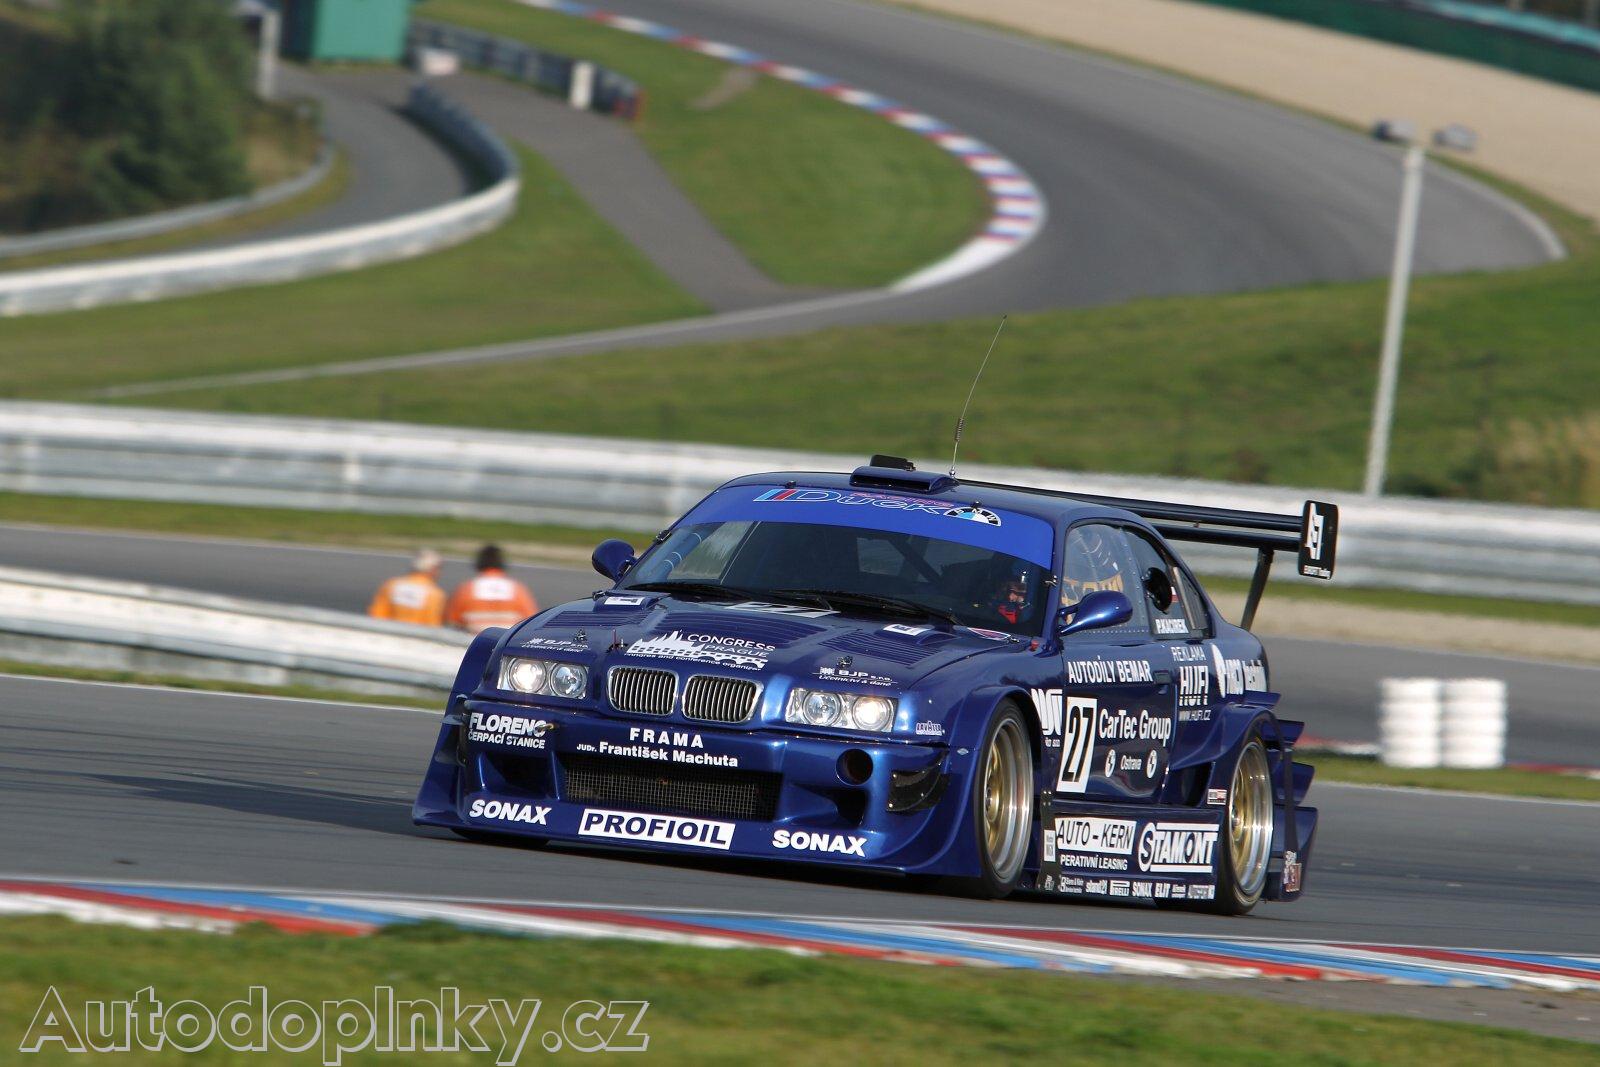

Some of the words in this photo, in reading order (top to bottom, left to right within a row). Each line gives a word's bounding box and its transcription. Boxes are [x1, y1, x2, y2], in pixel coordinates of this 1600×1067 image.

[687, 633, 776, 651] CONGRESS
[704, 644, 770, 658] PRAGUE
[1171, 646, 1207, 661] REKLAMA
[1067, 656, 1116, 684] AUTODÍLY
[1116, 660, 1153, 684] BEMAR
[468, 728, 506, 744] ČERPACÍ
[506, 735, 546, 750] STANICE
[1098, 708, 1138, 740] CarTec
[1139, 709, 1172, 747] Group
[576, 743, 598, 753] JUDr.
[599, 741, 668, 762] František
[672, 750, 738, 768] Machuta
[1062, 704, 1095, 783] 27
[469, 799, 552, 825] SONAX
[583, 812, 728, 846] PROFIOIL
[1056, 819, 1092, 847] AUTO
[1102, 820, 1133, 851] KERN
[772, 829, 868, 858] SONAX
[1138, 823, 1218, 872] STAMONT
[1060, 854, 1099, 868] PERATIVNÍ
[1098, 858, 1128, 871] LEASING
[1132, 881, 1153, 898] SONAX
